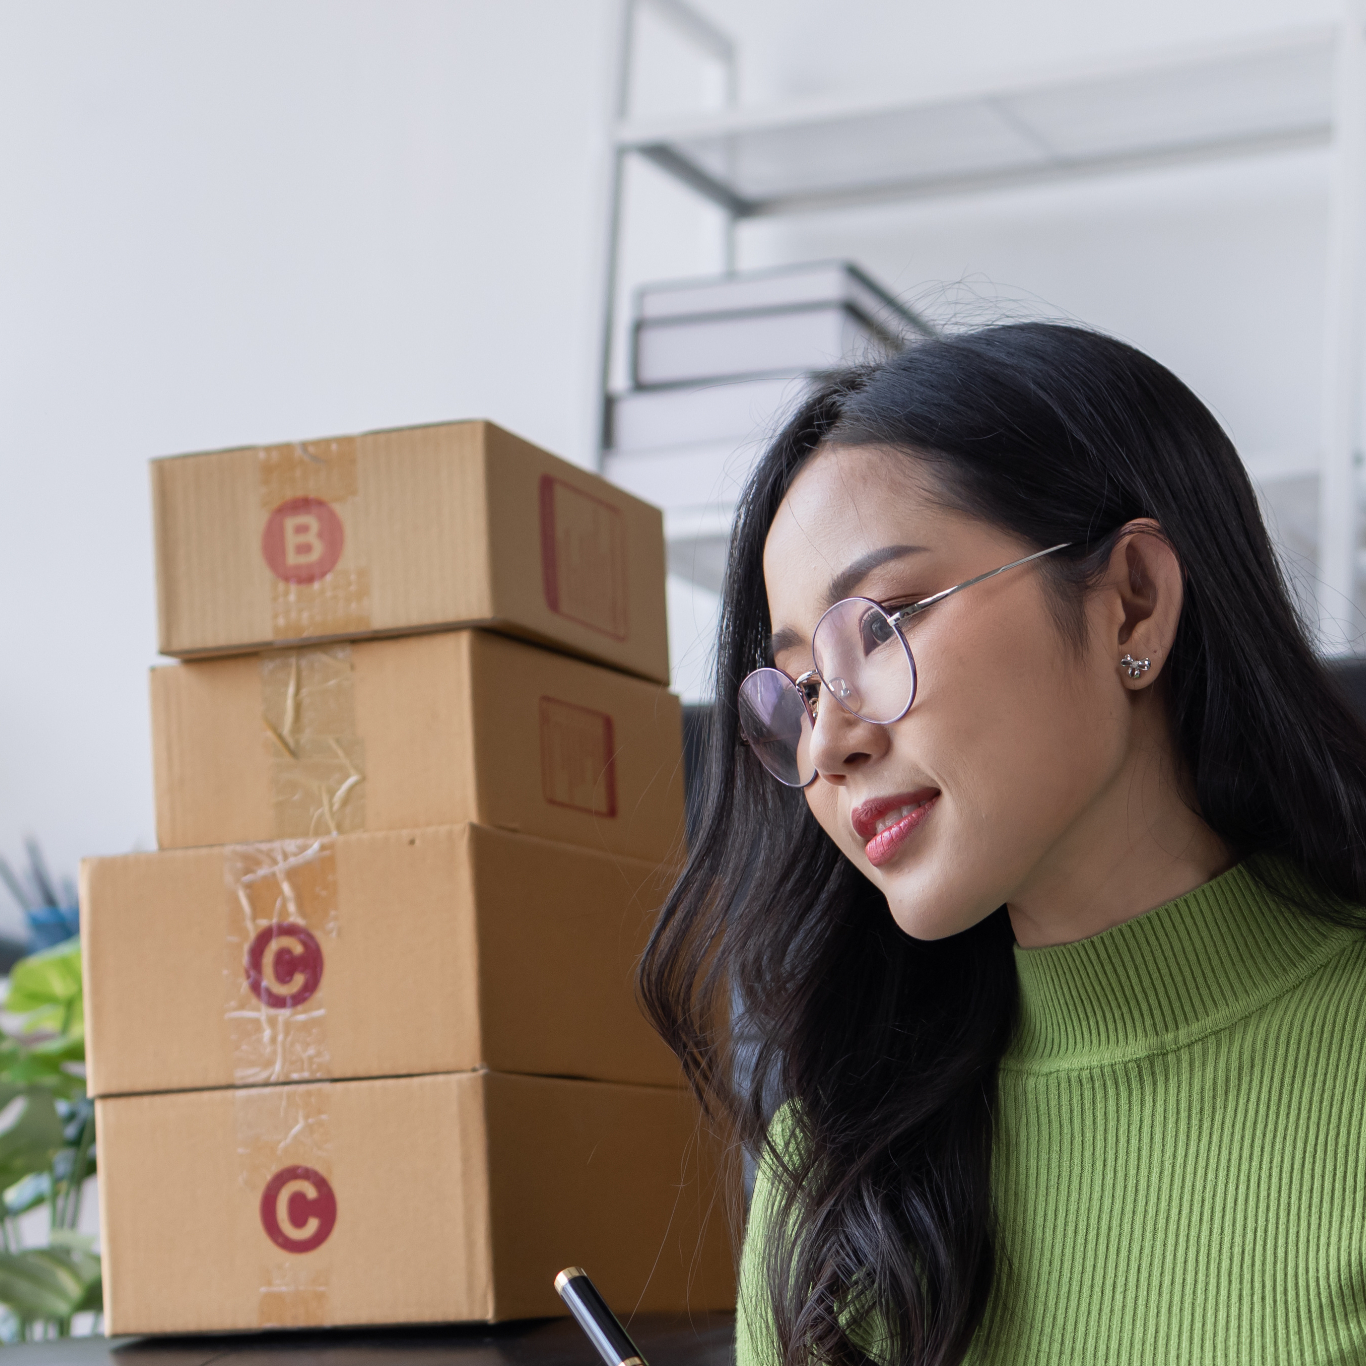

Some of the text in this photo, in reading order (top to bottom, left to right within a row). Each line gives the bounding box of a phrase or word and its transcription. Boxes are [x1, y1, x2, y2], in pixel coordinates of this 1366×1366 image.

[284, 515, 324, 566] B
[262, 936, 305, 998] C
[276, 1178, 320, 1241] C
